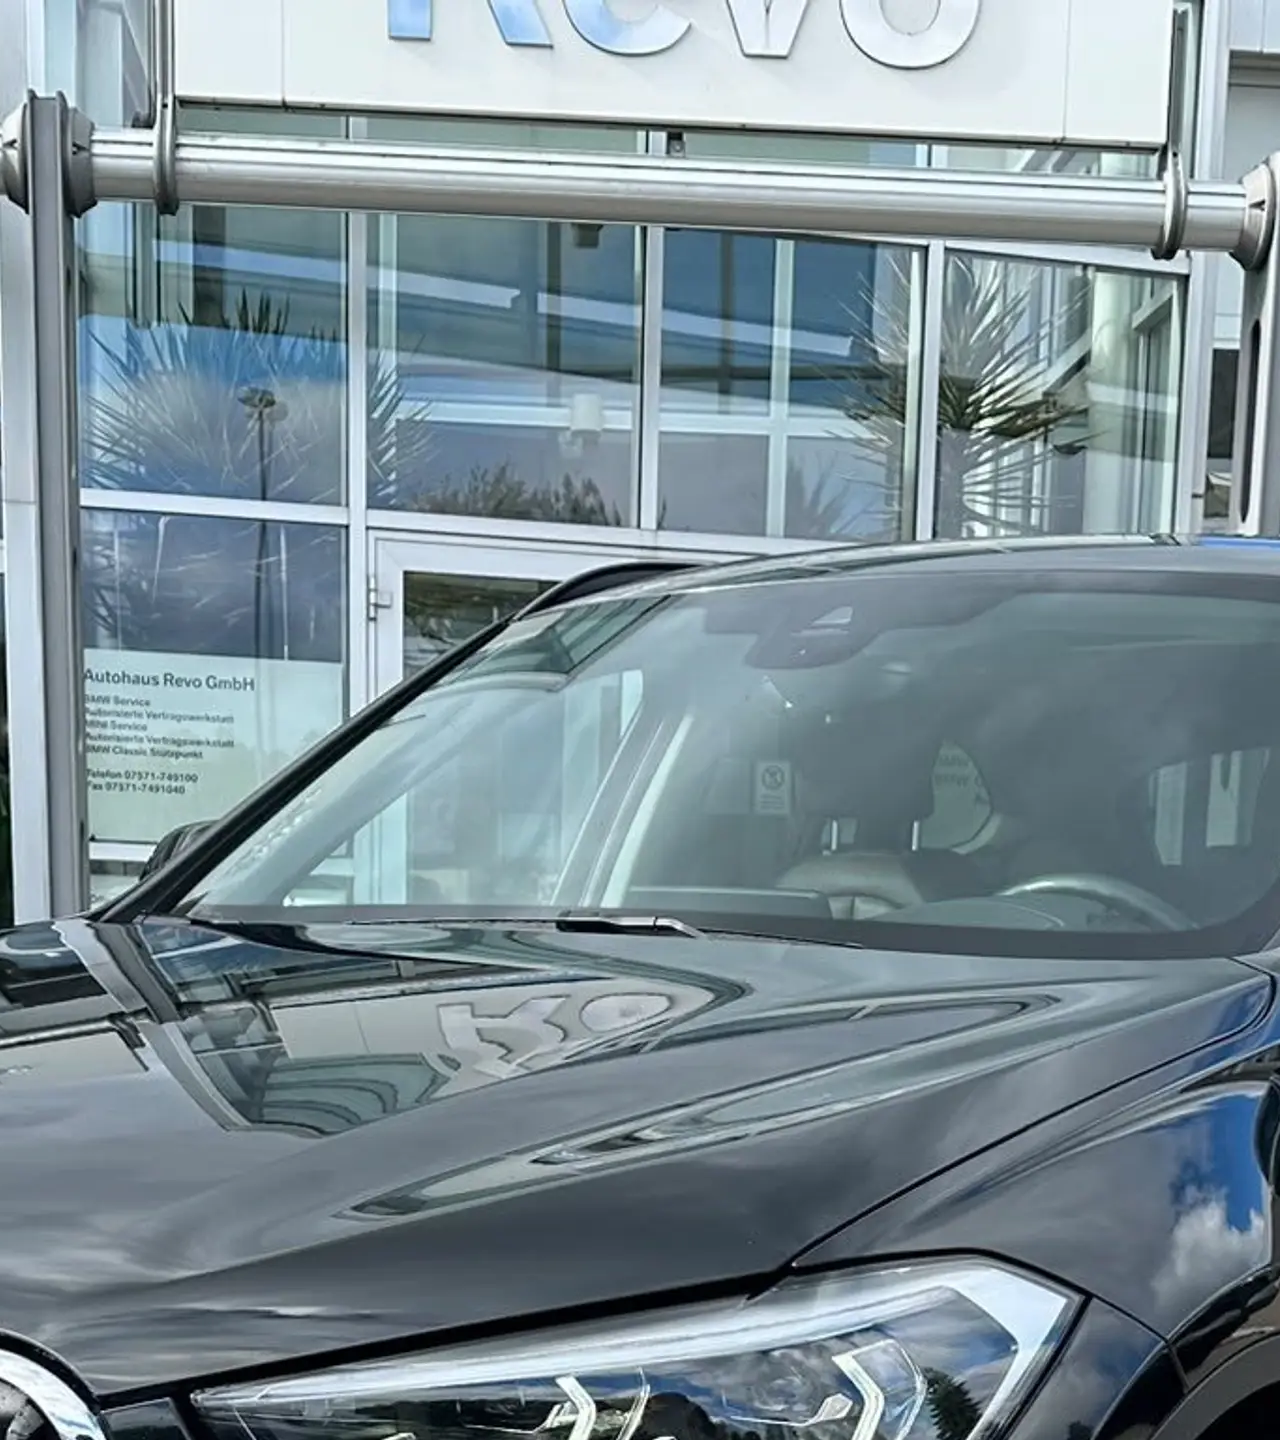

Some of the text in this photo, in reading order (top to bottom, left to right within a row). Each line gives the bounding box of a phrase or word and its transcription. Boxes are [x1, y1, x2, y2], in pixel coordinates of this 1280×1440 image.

[84, 668, 255, 691] Autohaus Revo GmbH
[113, 695, 151, 706] Service
[110, 721, 147, 731] Service
[86, 768, 122, 780] Telefon
[86, 781, 103, 791] Fax
